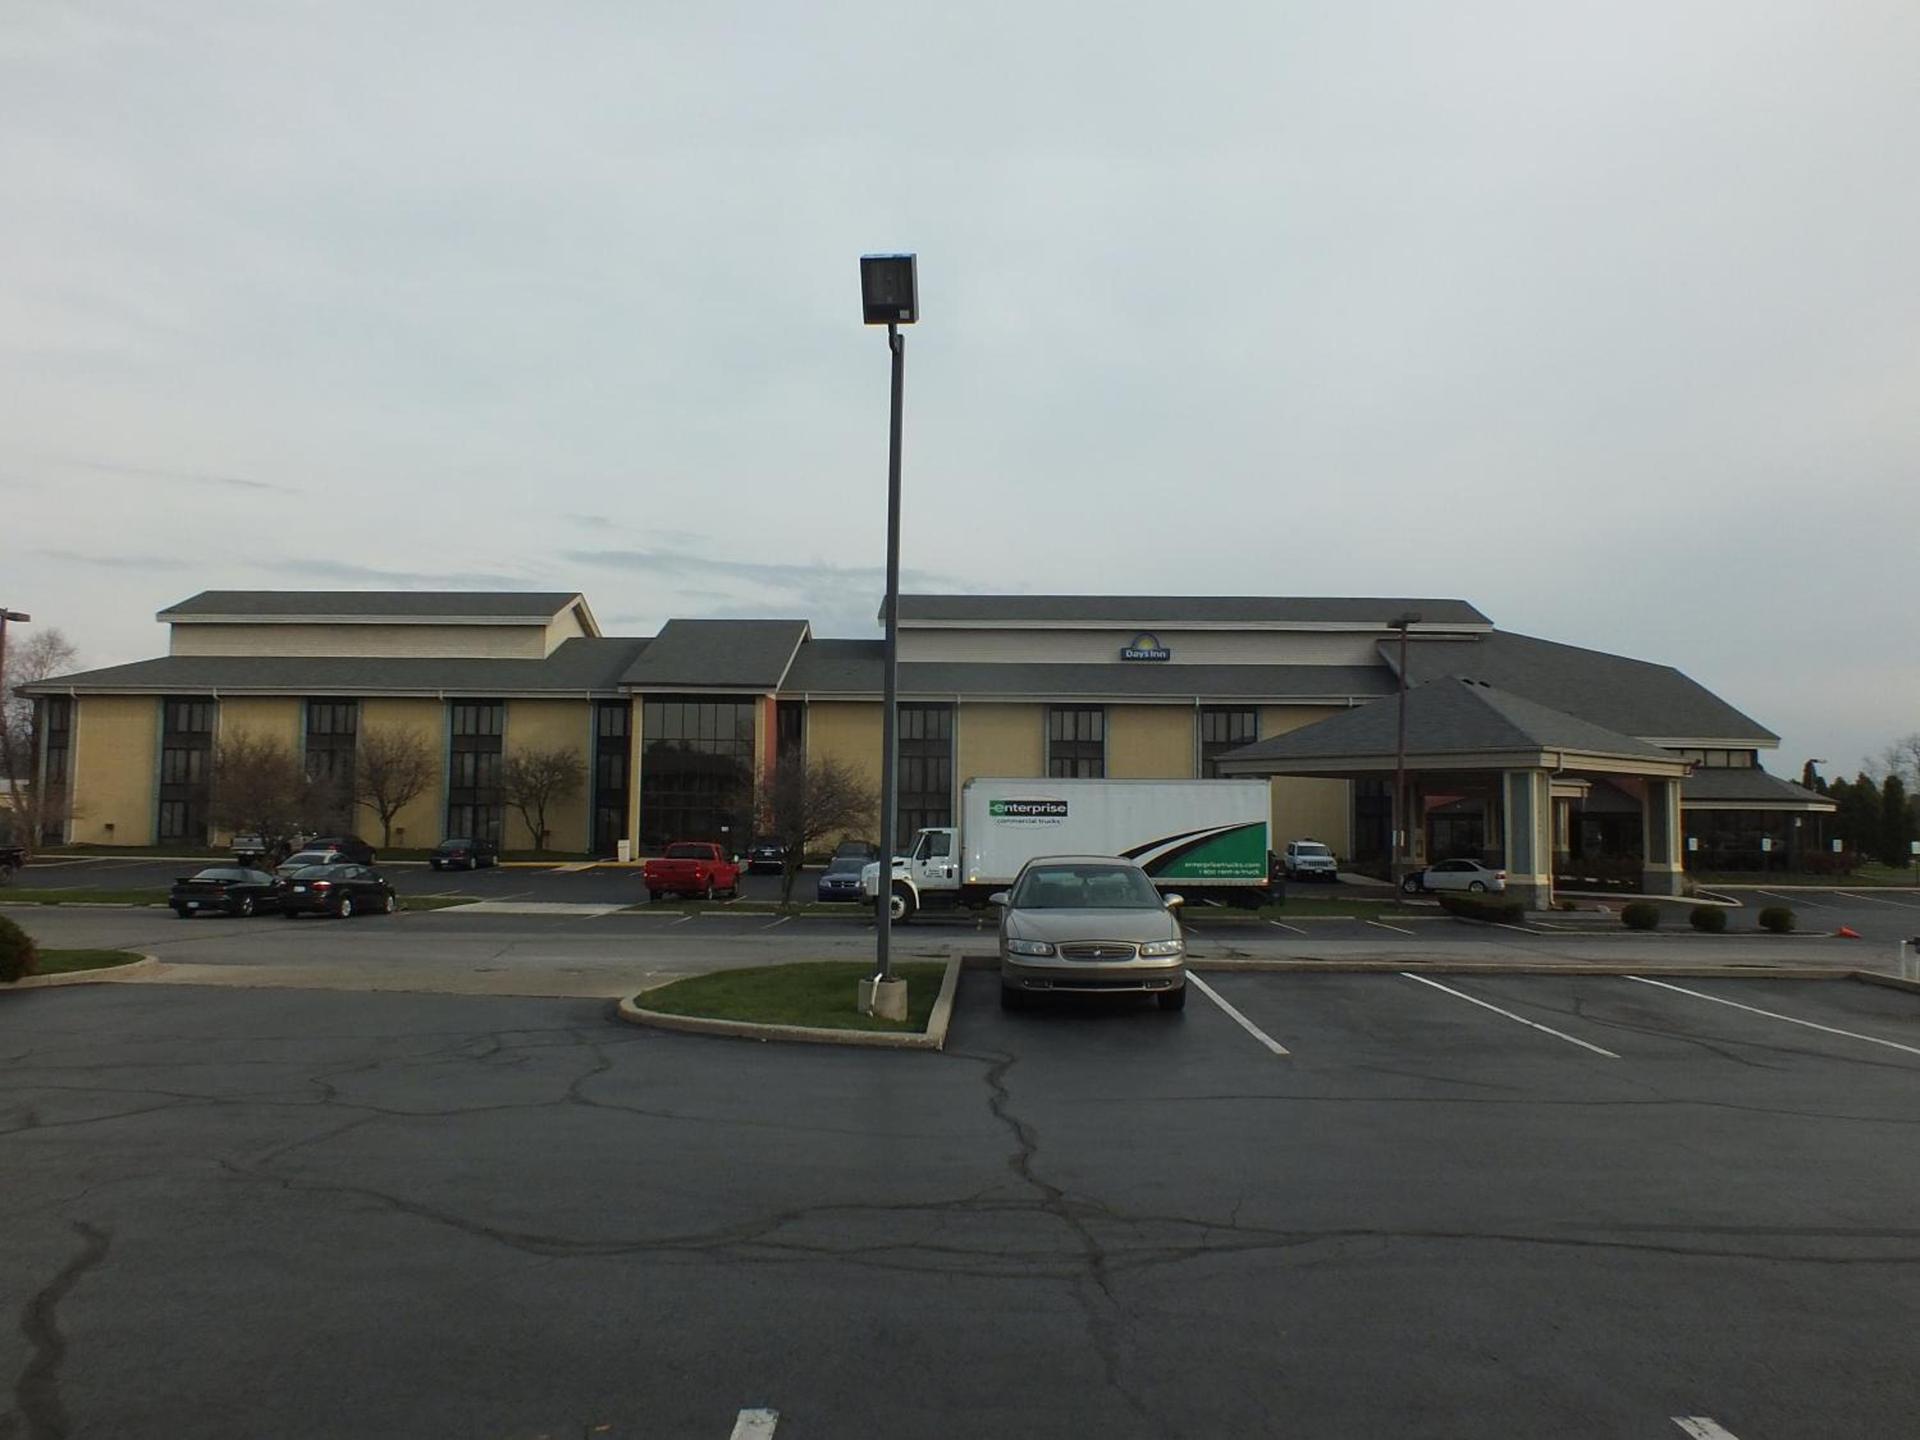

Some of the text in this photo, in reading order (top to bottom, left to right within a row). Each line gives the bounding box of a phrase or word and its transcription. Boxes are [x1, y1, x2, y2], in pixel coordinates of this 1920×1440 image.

[1125, 650, 1167, 659] Days Inn
[991, 803, 1067, 814] enterprise
